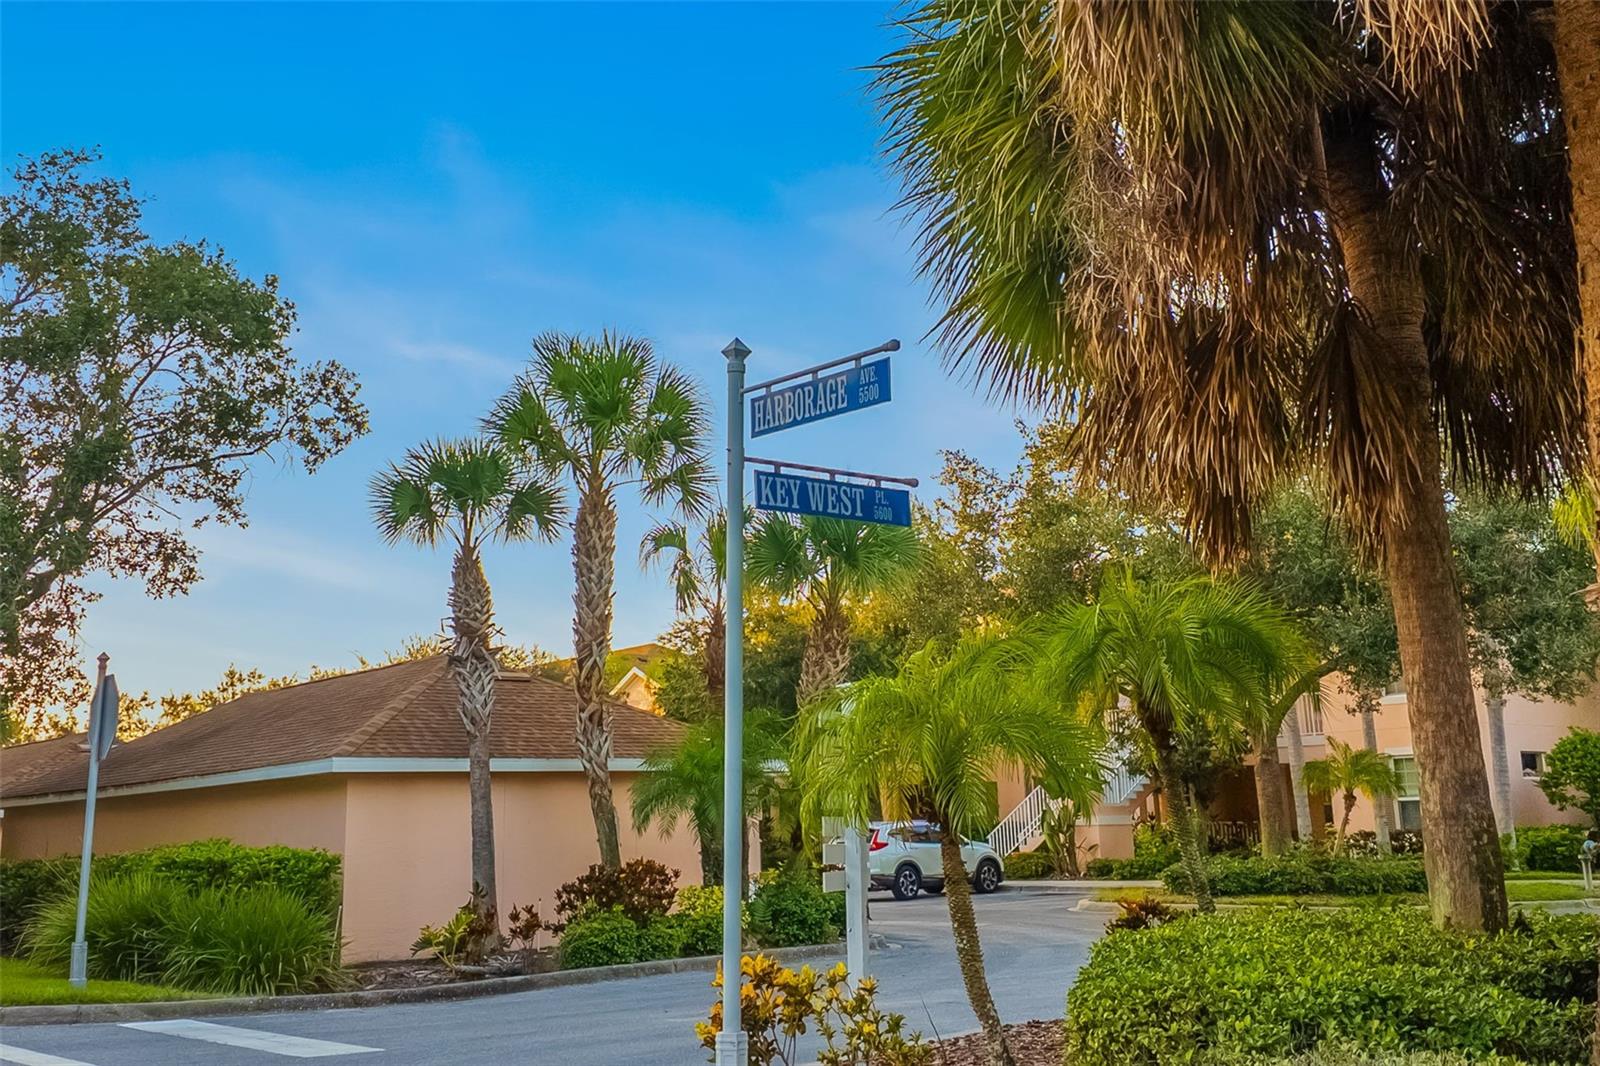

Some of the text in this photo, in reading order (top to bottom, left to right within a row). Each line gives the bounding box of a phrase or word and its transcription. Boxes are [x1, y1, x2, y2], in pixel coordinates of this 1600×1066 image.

[754, 375, 848, 432] HARBORAGE
[859, 384, 879, 403] 5500
[760, 475, 865, 517] KEY WEST
[873, 505, 893, 521] 5600
